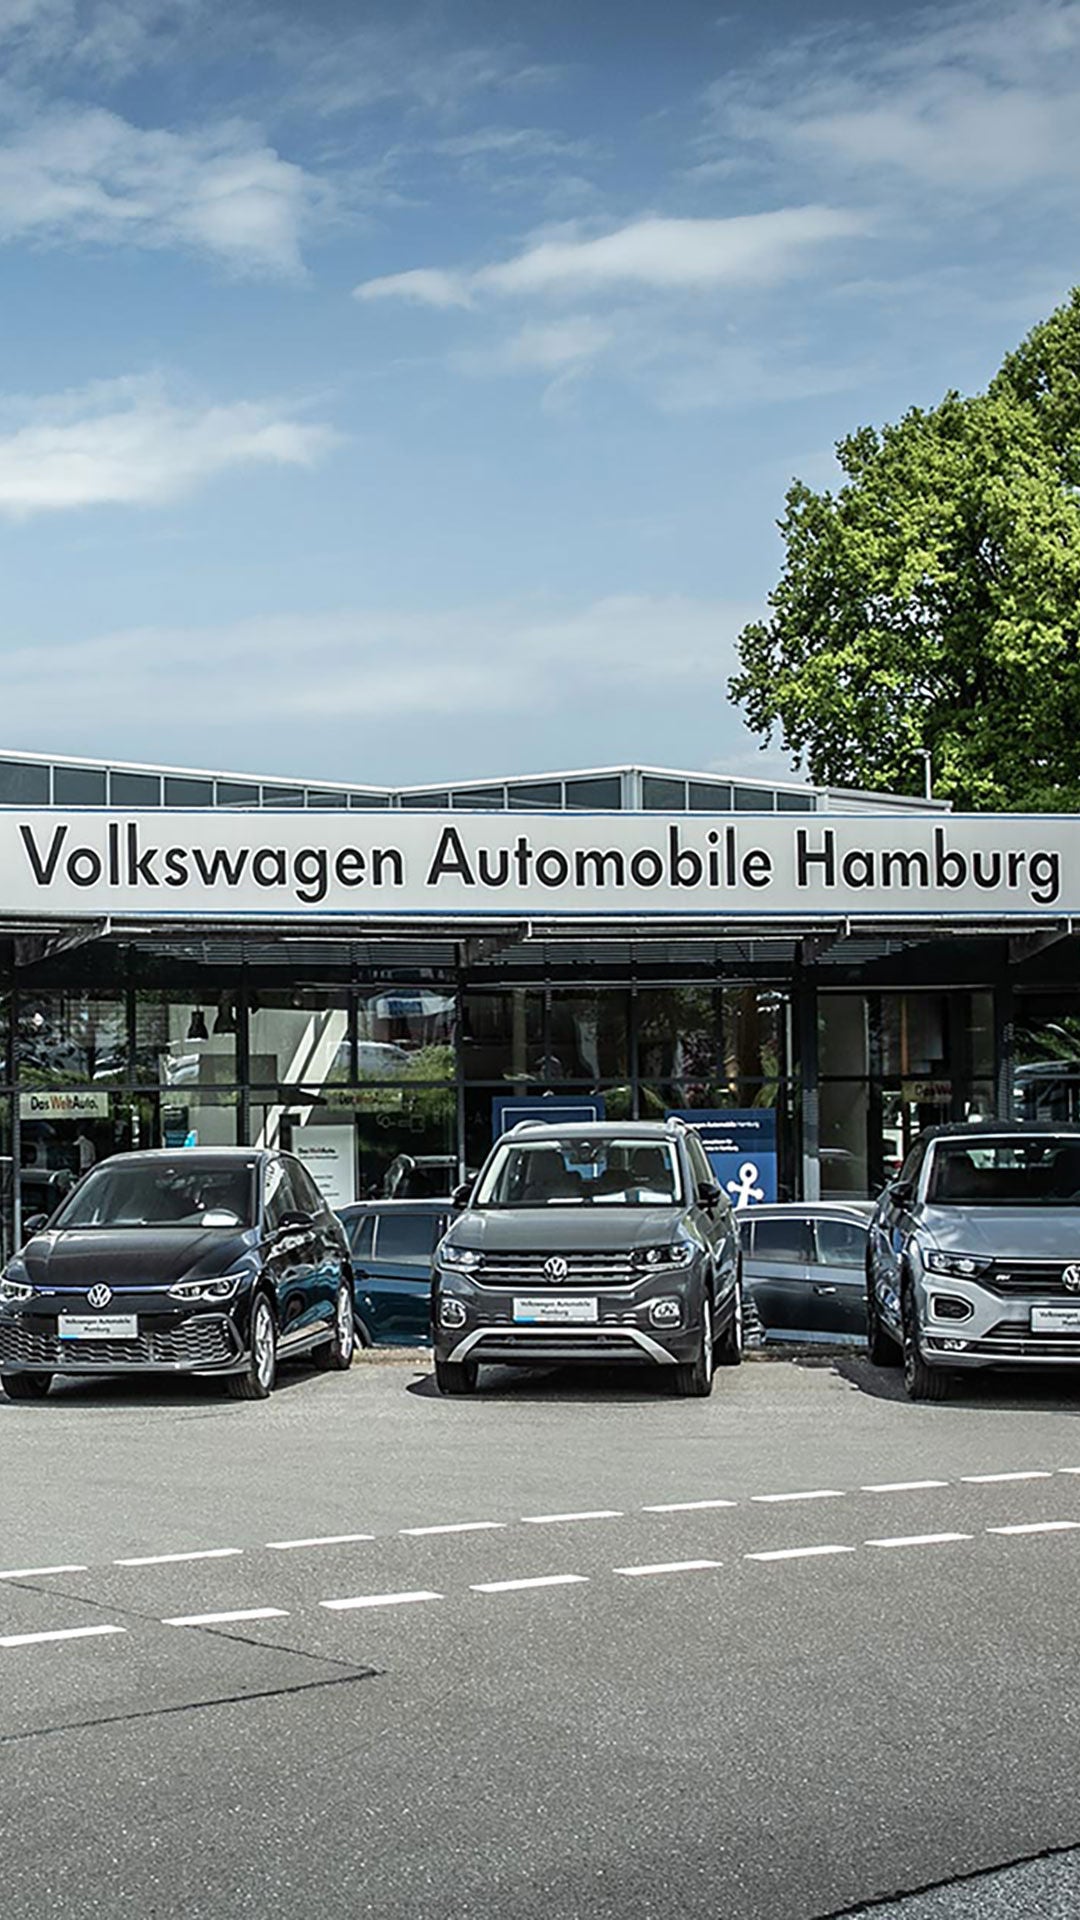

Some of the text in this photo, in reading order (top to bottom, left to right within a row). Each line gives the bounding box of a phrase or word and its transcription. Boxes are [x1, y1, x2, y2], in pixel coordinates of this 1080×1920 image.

[20, 823, 1059, 903] Volkswagen Automobile Hamburg
[31, 1095, 50, 1111] Das
[87, 1282, 113, 1309] VW
[521, 1300, 591, 1308] Volkswagen Automobile
[541, 1309, 570, 1317] Hamburg
[1039, 1311, 1078, 1320] Volkswagen
